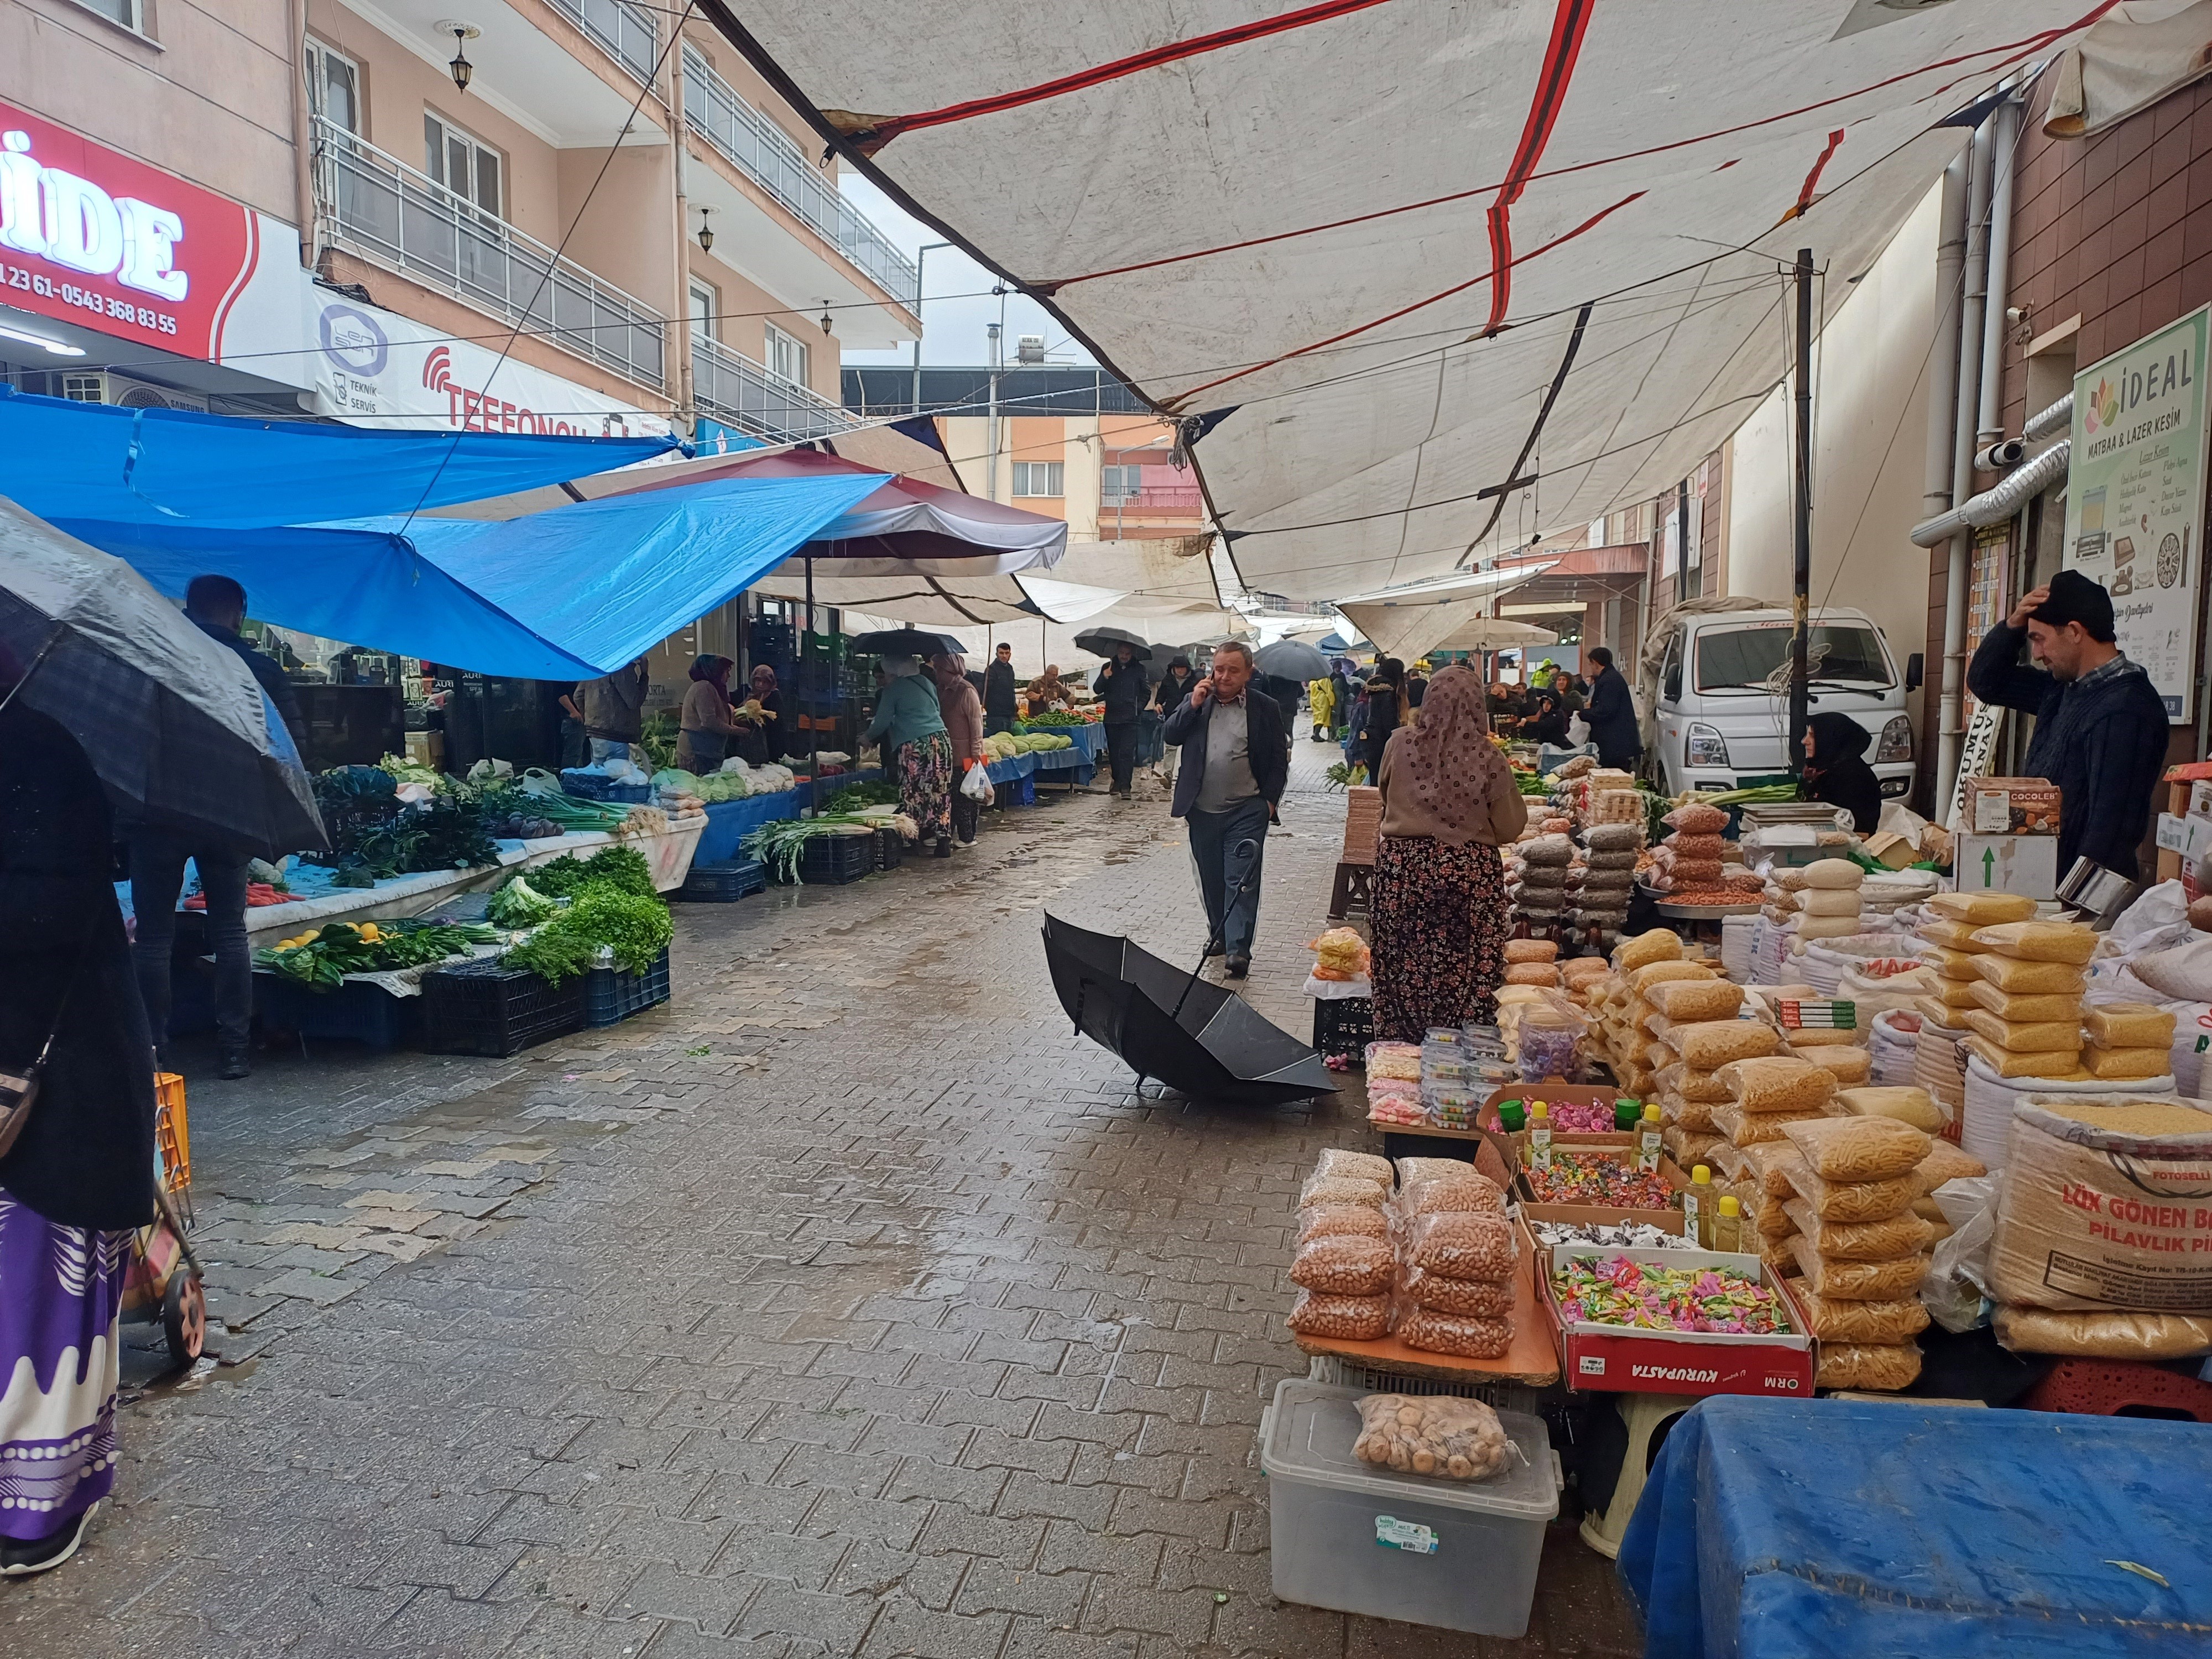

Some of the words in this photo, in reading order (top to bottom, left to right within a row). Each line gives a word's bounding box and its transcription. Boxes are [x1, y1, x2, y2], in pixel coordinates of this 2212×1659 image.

[7, 266, 30, 290] 23
[33, 274, 103, 313] 61-0543
[105, 297, 135, 323] 368
[137, 307, 156, 329] 83
[158, 313, 176, 335] 55
[350, 380, 377, 397] TEKNİK
[2120, 349, 2192, 413] İDEAL
[170, 399, 205, 414] SAMSUNG
[351, 398, 376, 414] SERVİS
[2088, 435, 2116, 460] MATBAA
[2119, 432, 2124, 448] &
[2127, 420, 2152, 445] LAZER
[2154, 406, 2180, 435] KESİM
[2153, 1170, 2211, 1181] FOTOSELLİ
[2063, 1183, 2102, 1214] LÜX
[2109, 1197, 2187, 1228] GÖNEN
[2089, 1221, 2186, 1252] PİLAVLIK
[1631, 1364, 1718, 1383] KURUPASTA
